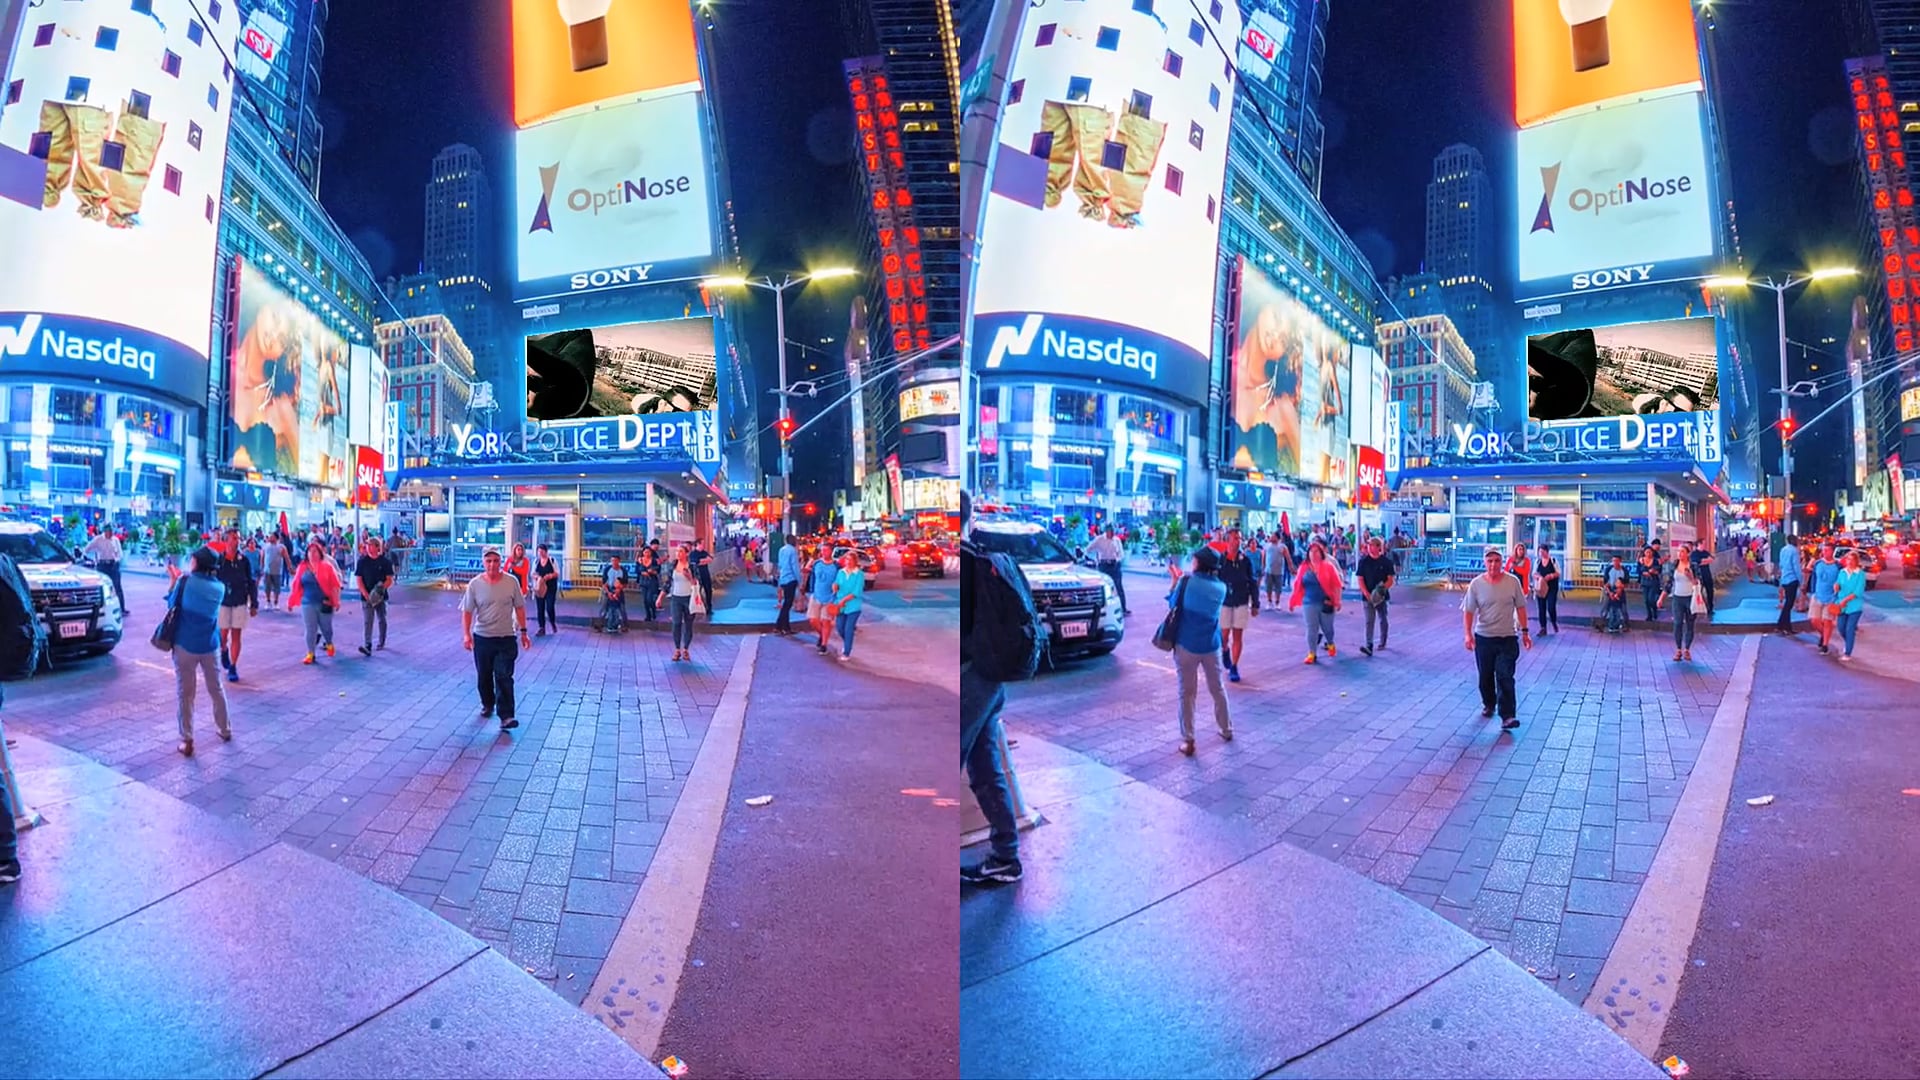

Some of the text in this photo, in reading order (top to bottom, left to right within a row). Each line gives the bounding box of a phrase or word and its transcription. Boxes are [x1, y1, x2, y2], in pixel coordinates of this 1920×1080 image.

[567, 174, 690, 216] OptiNose
[1568, 174, 1691, 216] OptiNose
[570, 264, 653, 290] SONY
[1571, 264, 1654, 290] SONY
[41, 328, 156, 380] Nasdaq
[1042, 328, 1157, 380] Nasdaq
[387, 404, 396, 468] NYPD
[451, 423, 513, 456] YORK
[521, 422, 609, 453] POLICE
[702, 409, 714, 460] NYPD
[1388, 404, 1397, 468] NYPD
[1452, 423, 1514, 456] YORK
[1522, 422, 1610, 453] POLICE
[1703, 409, 1715, 460] NYPD
[466, 491, 501, 502] POLICE
[592, 490, 634, 502] POLICE
[1467, 491, 1502, 502] POLICE
[1593, 490, 1635, 502] POLICE
